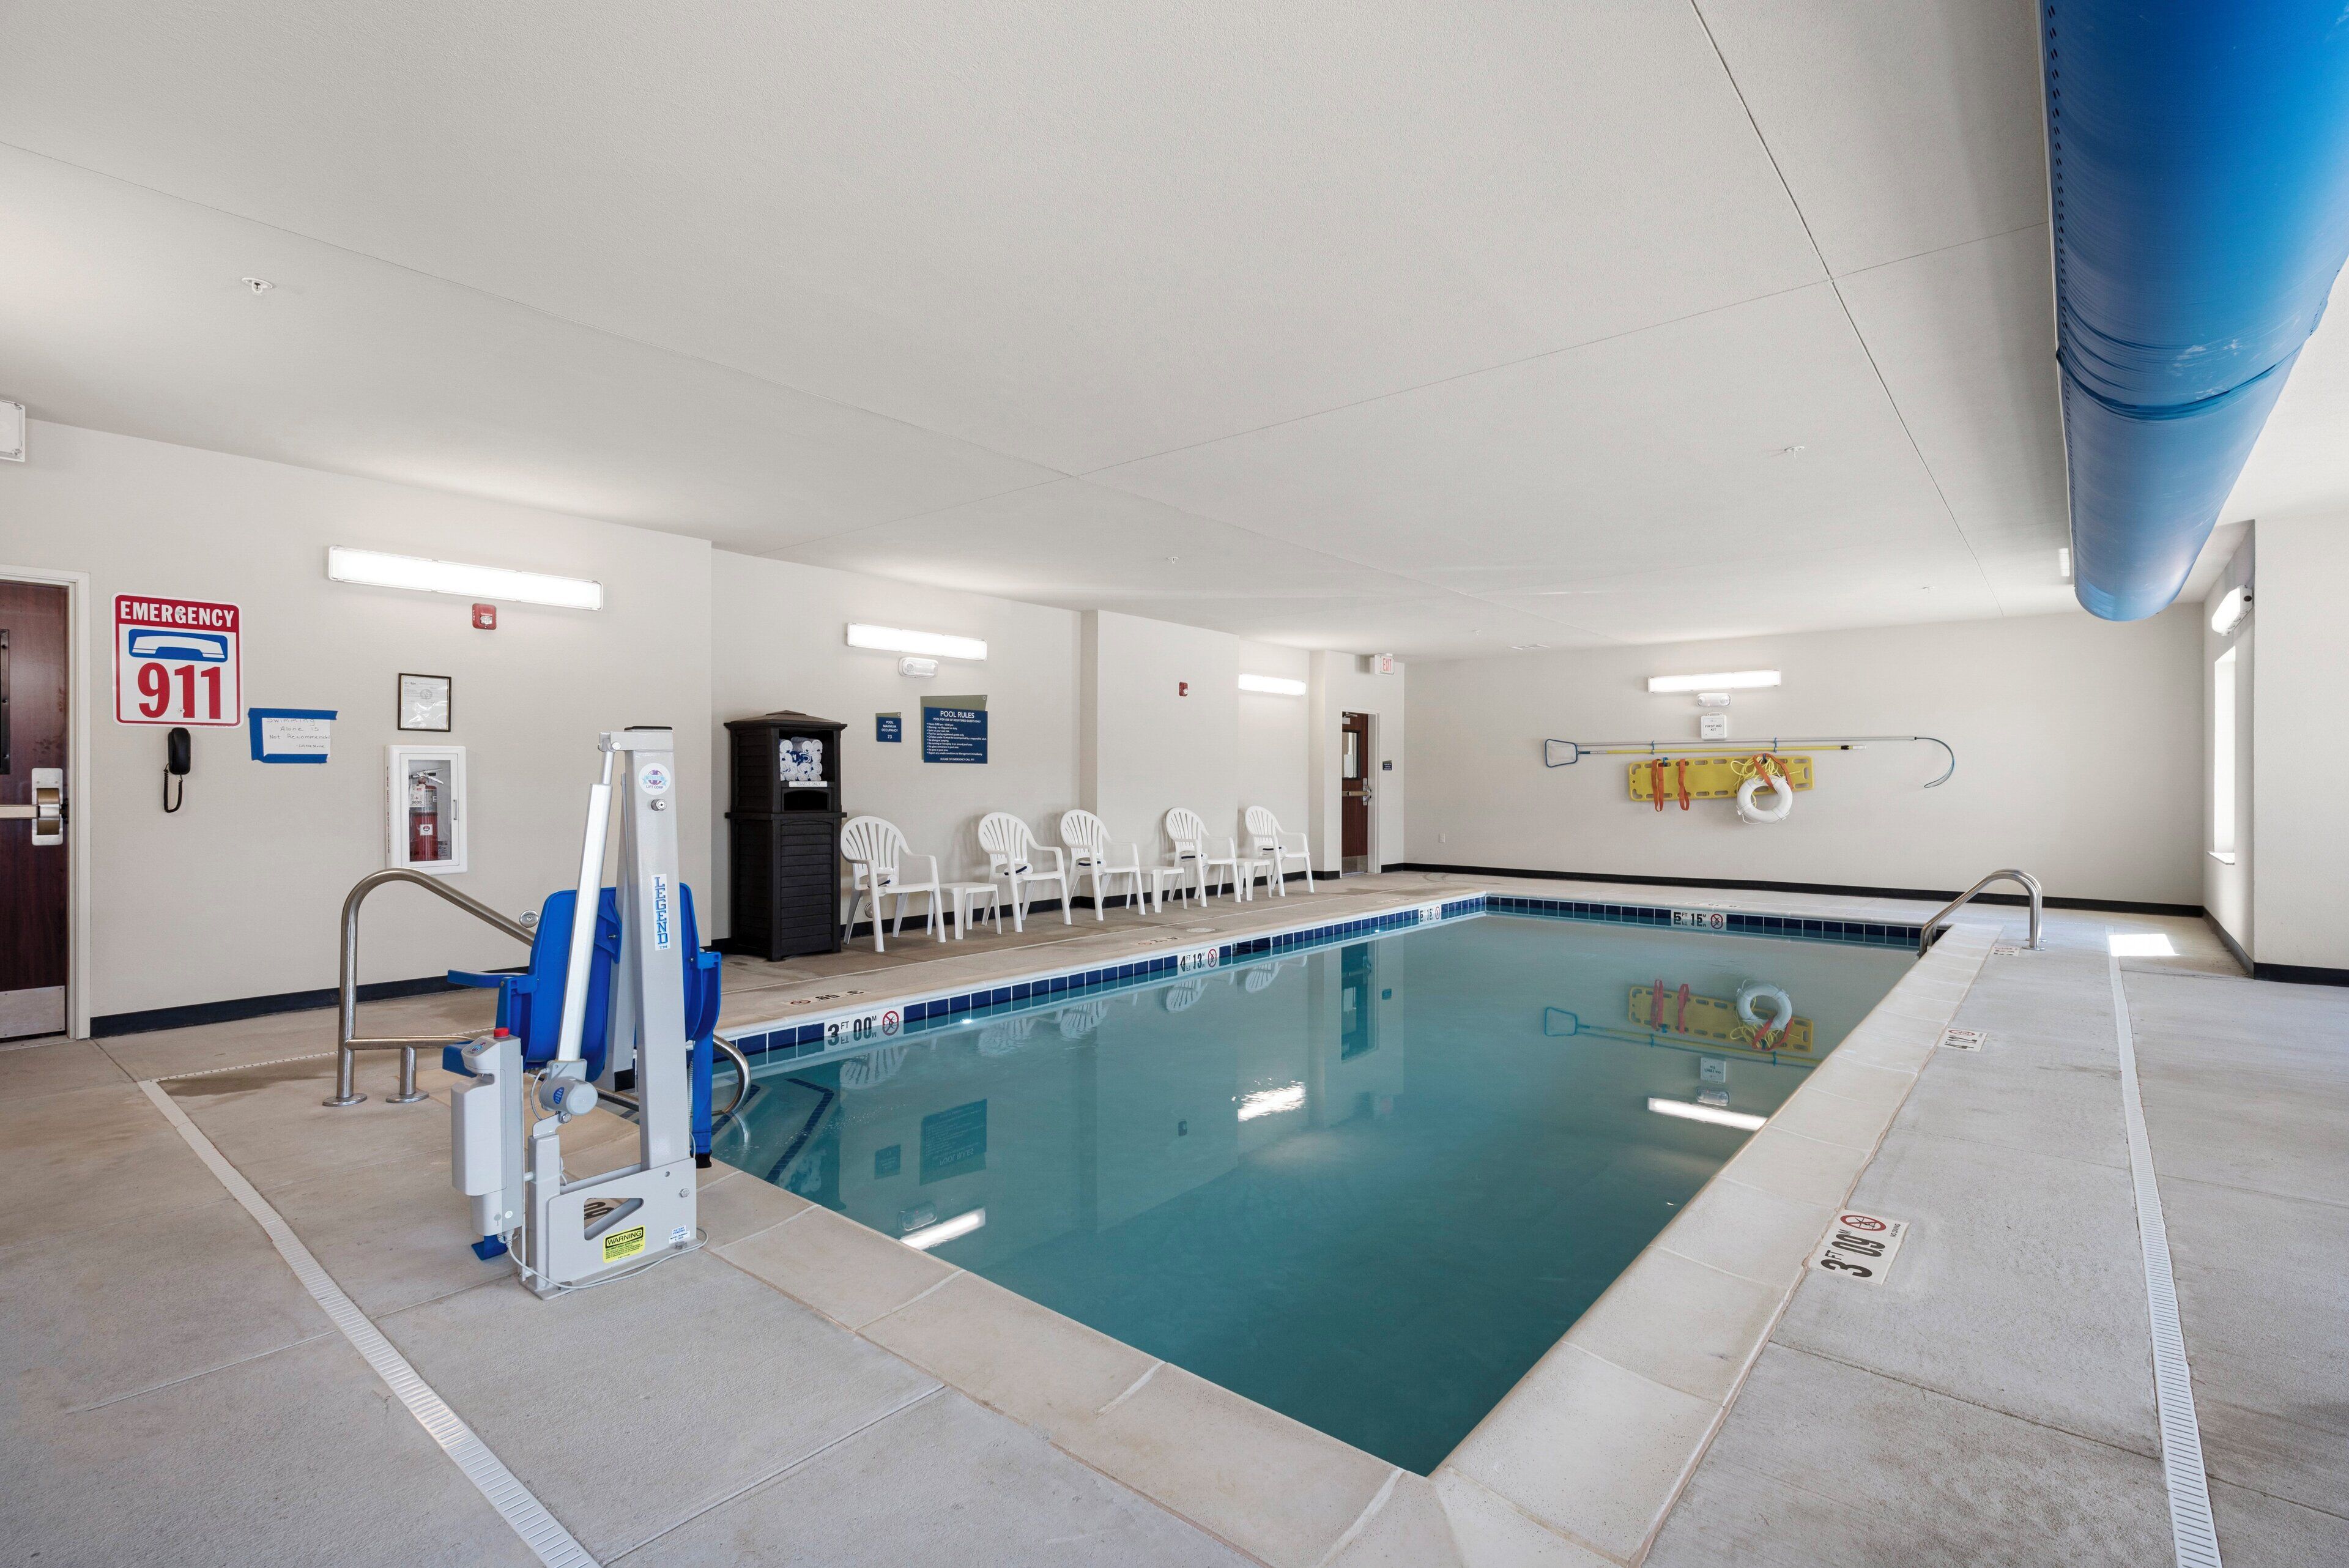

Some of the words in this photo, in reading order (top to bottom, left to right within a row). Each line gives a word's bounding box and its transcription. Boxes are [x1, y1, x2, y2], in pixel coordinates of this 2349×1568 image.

[121, 601, 234, 627] EMERGENCY
[1383, 658, 1392, 672] EXIT
[138, 662, 221, 719] 911
[655, 877, 668, 945] LEGEND
[841, 1020, 850, 1030] FT
[1892, 1223, 1901, 1233] DIVING
[607, 1230, 642, 1245] WARNING
[1825, 1249, 1844, 1260] FT
[1820, 1259, 1872, 1277] 3
